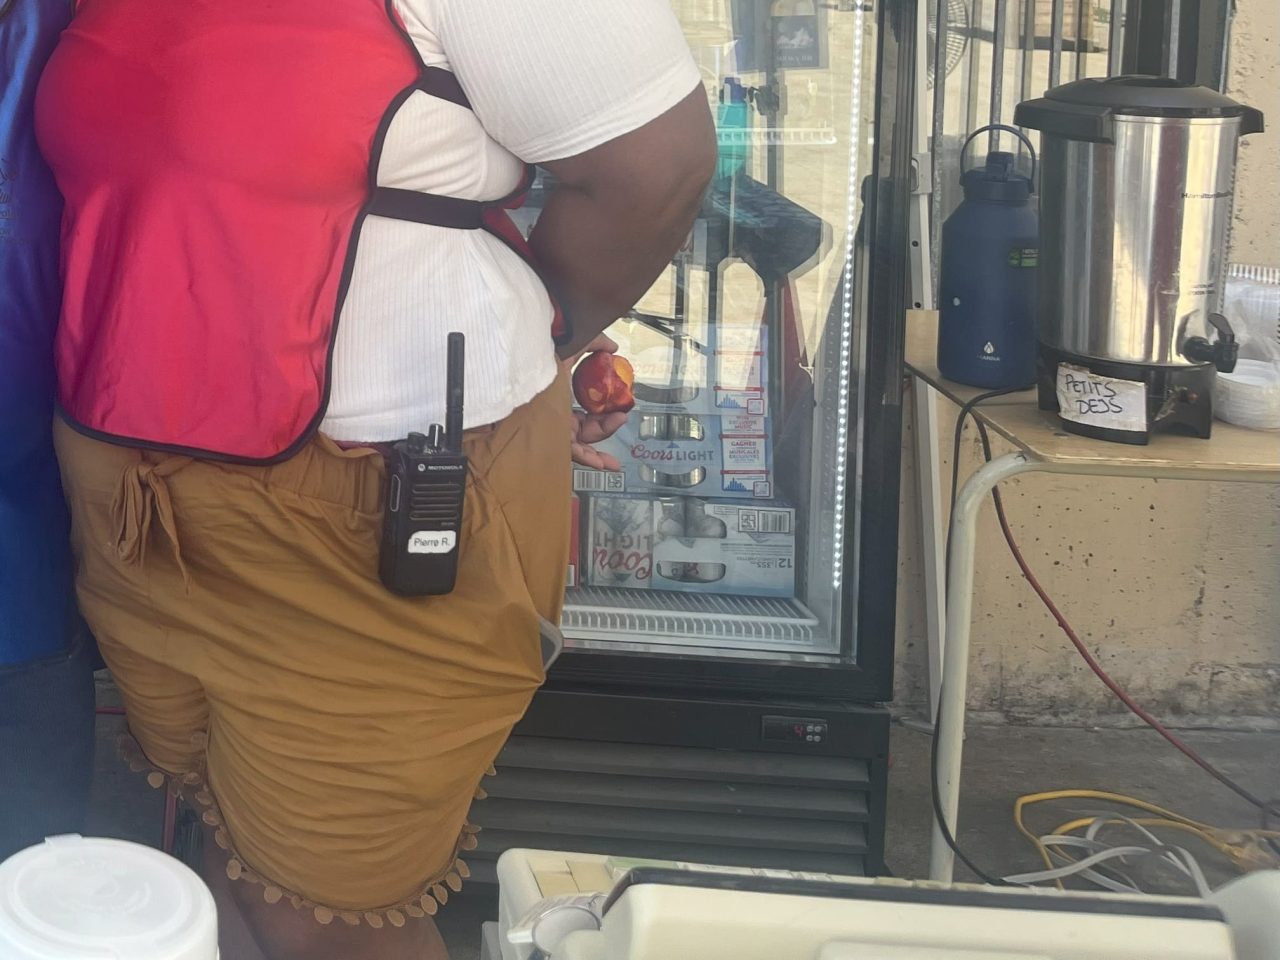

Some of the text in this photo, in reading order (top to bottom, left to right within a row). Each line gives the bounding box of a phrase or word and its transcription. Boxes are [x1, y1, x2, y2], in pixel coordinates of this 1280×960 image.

[1065, 373, 1117, 398] PETITS
[630, 444, 714, 461] Coors LIGHT
[414, 537, 439, 547] Pierre
[778, 558, 793, 569] 12
